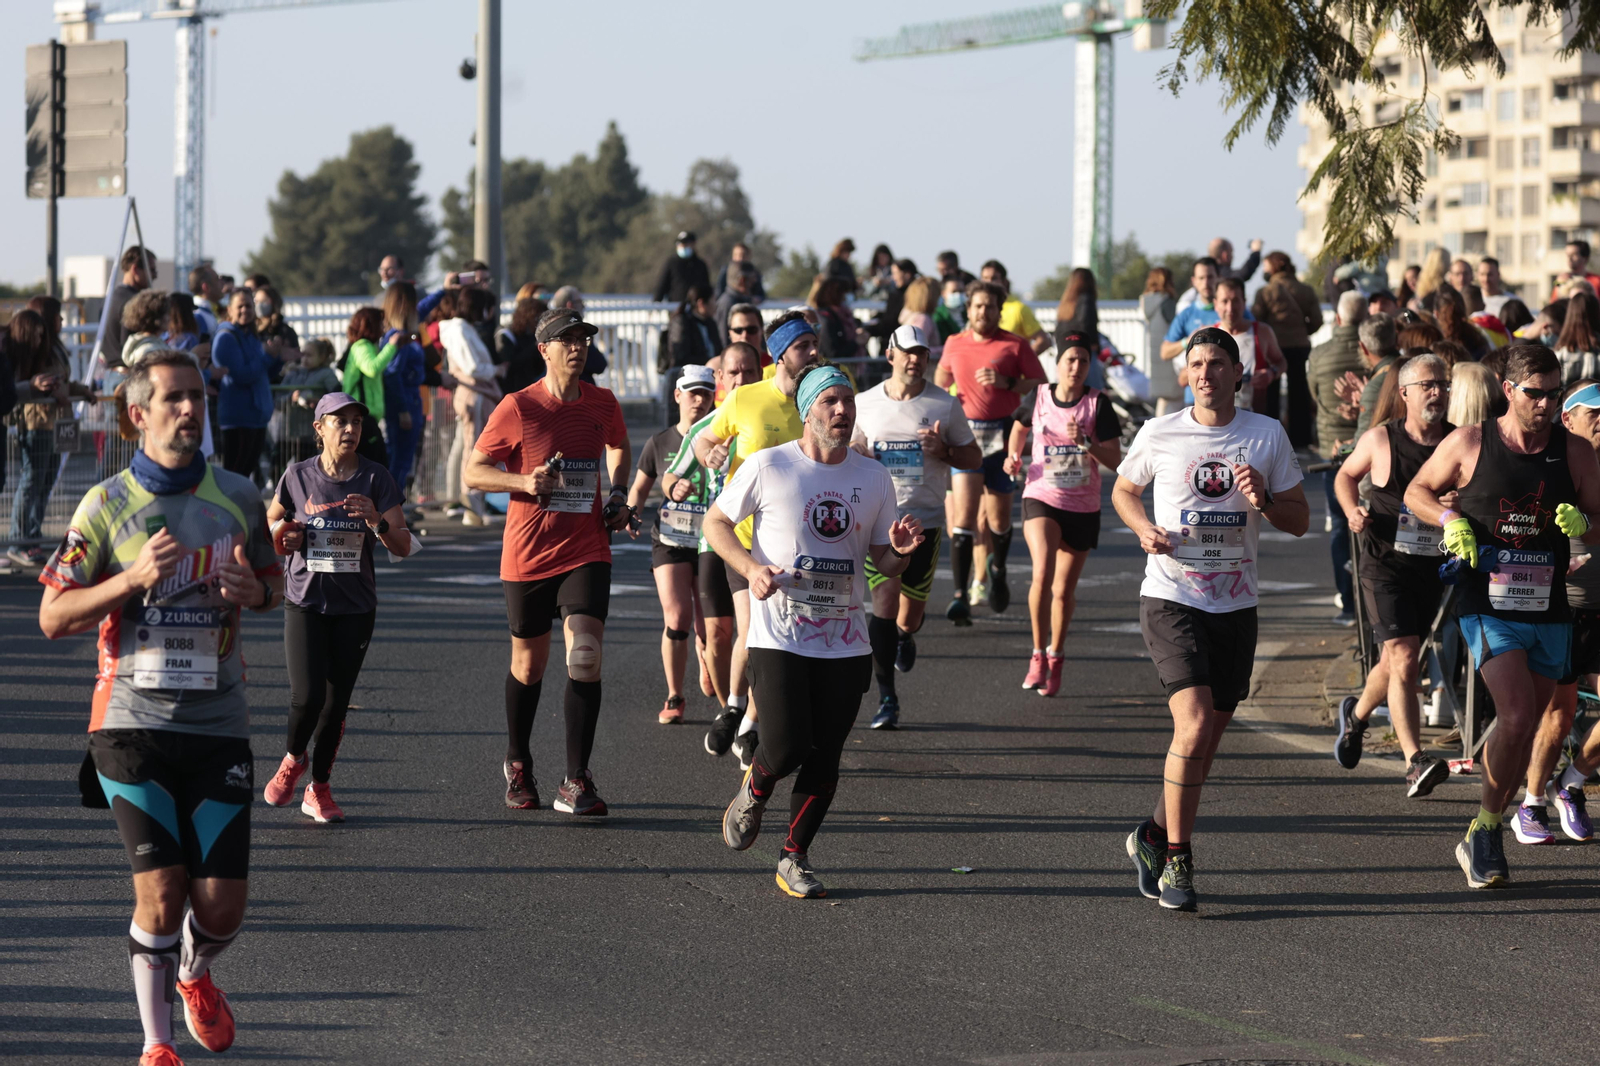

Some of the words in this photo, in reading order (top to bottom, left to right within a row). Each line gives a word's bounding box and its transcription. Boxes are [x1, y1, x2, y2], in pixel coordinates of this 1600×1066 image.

[60, 424, 76, 438] AMS
[566, 461, 596, 469] ZURICH
[888, 457, 909, 465] 11233
[1184, 460, 1197, 484] PURETAS
[1206, 452, 1227, 460] PATAS
[565, 478, 584, 487] 9439
[551, 490, 580, 499] MOROCCO
[677, 503, 707, 513] ZURICH
[803, 498, 815, 522] PURETAS
[823, 491, 843, 499] PATAS
[1202, 515, 1240, 524] ZURICH
[1508, 512, 1536, 523] XXXVII
[326, 521, 360, 530] ZURICH
[1501, 524, 1540, 535] MARATÓN
[326, 537, 345, 546] 9438
[1201, 533, 1224, 543] 8814
[1416, 535, 1432, 543] ATEO
[313, 550, 342, 559] MOROCCO
[343, 551, 357, 559] NOW
[1202, 549, 1222, 557] JOSE
[1512, 553, 1548, 563] ZURICH
[816, 561, 849, 571] ZURICH
[1511, 572, 1533, 582] 6841
[812, 579, 835, 590] 8813
[1507, 587, 1535, 596] FERRER
[806, 594, 836, 604] JUAMPE
[164, 612, 212, 624] ZURICH
[164, 637, 194, 650] 8088
[165, 659, 192, 669] FRAN
